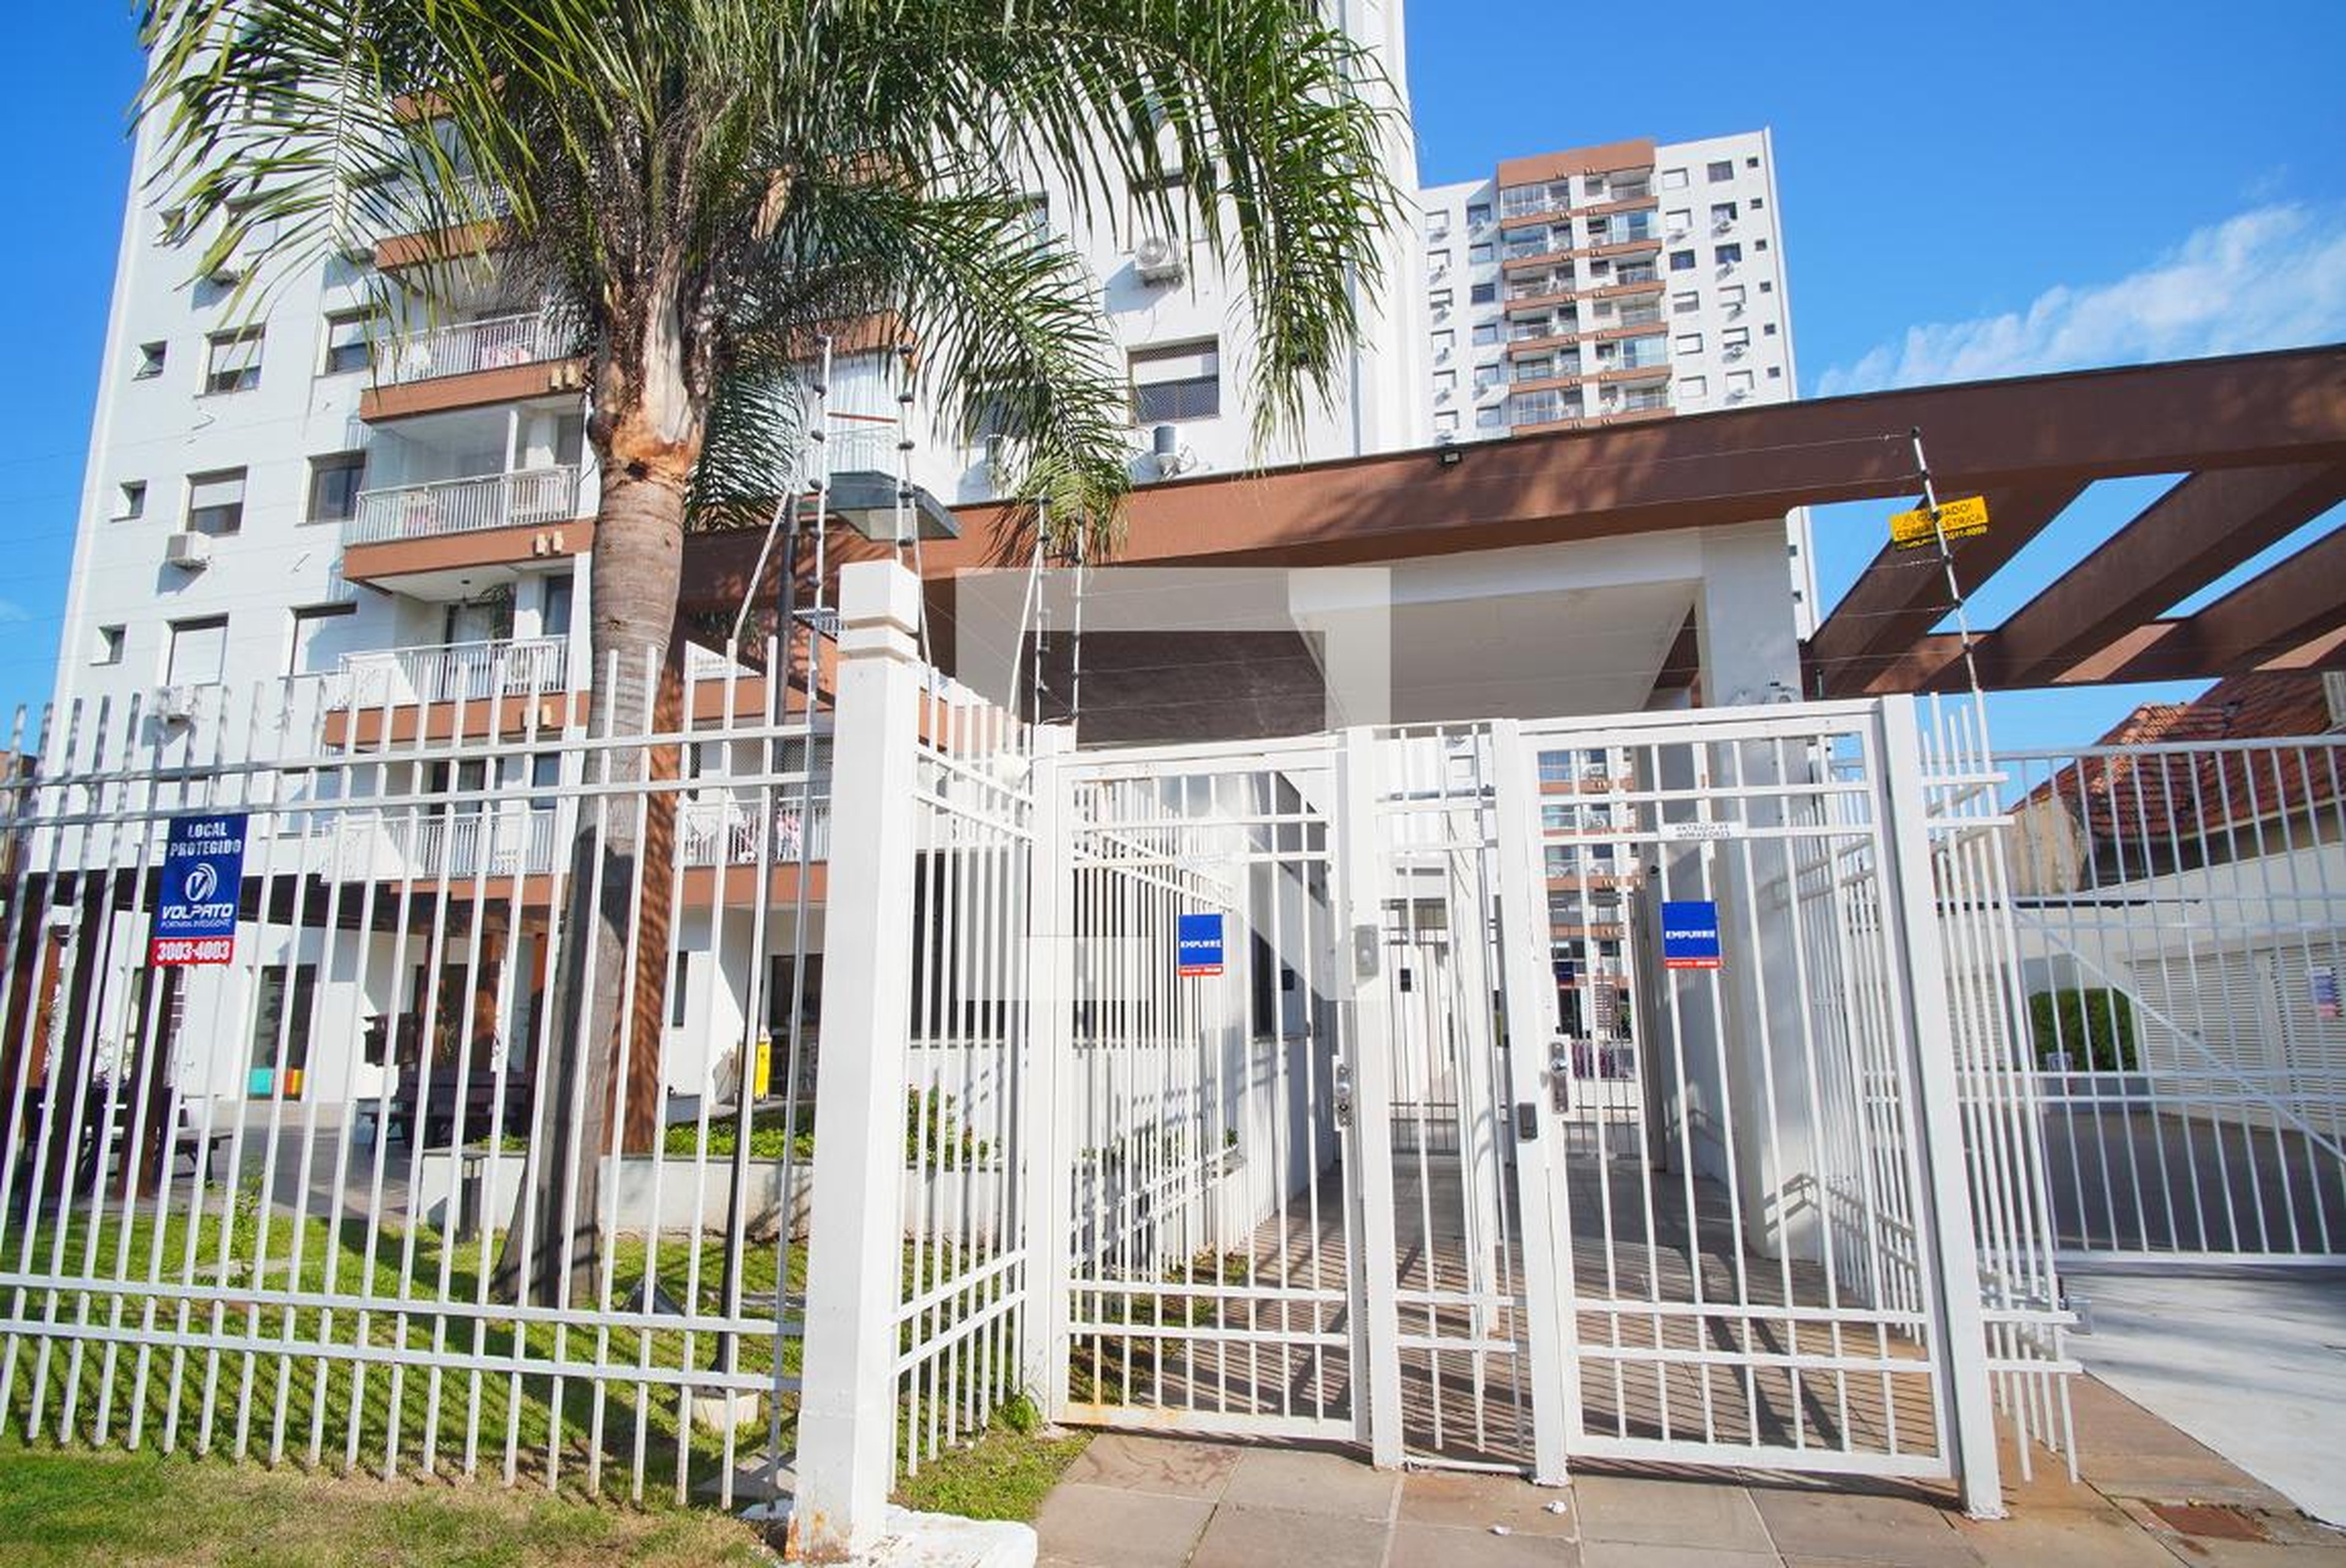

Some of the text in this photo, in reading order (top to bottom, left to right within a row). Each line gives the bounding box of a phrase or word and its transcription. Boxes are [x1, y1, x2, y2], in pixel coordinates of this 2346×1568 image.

[188, 822, 227, 838] LOCAL
[170, 839, 242, 856] PROTEGIDO
[162, 903, 233, 919] VOLPATO
[156, 941, 230, 961] 3003-4003
